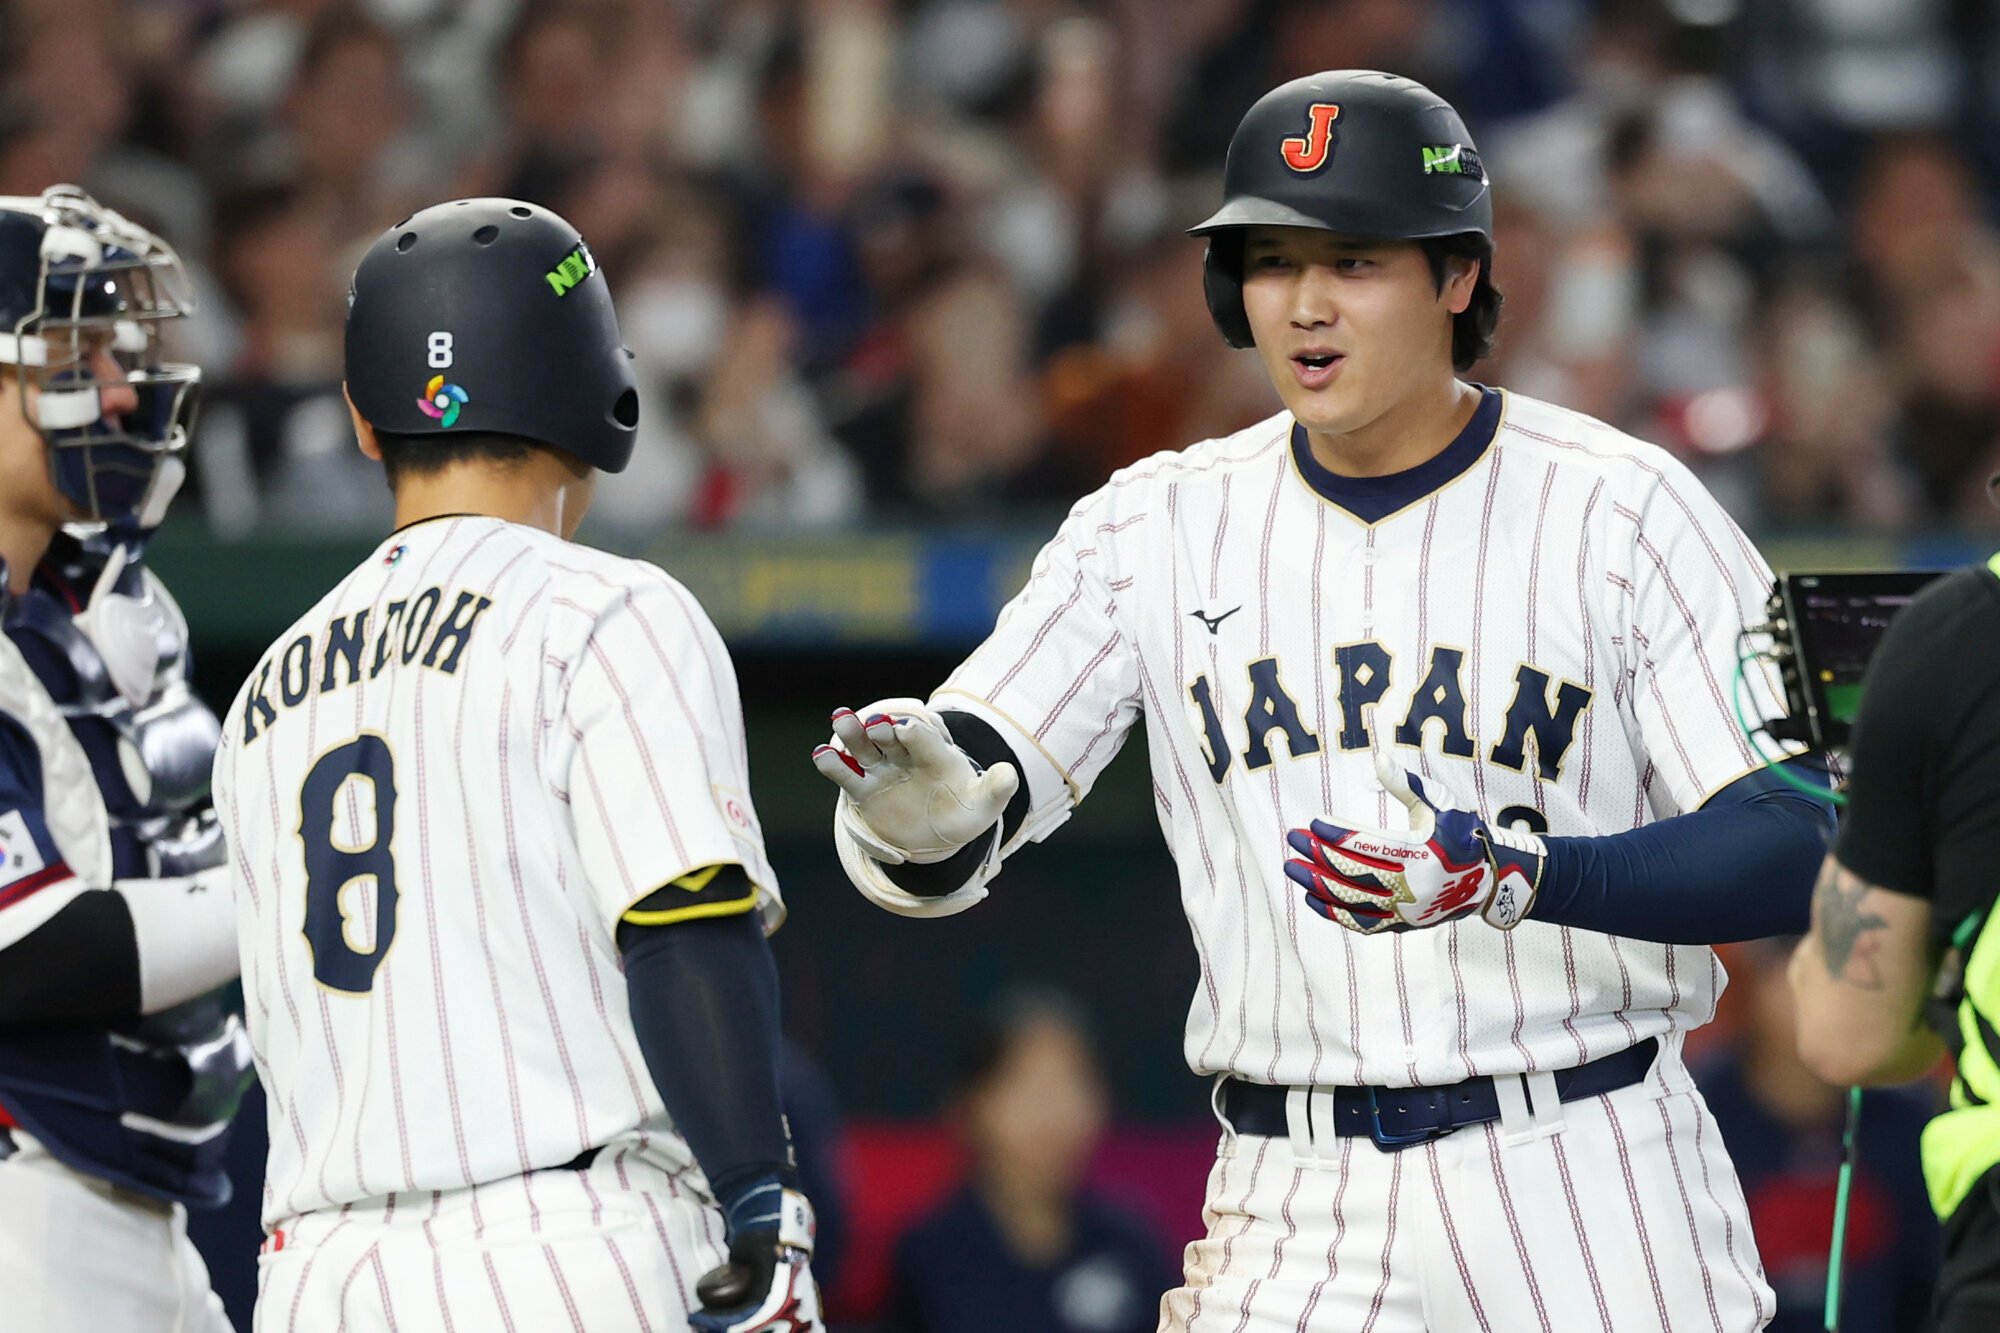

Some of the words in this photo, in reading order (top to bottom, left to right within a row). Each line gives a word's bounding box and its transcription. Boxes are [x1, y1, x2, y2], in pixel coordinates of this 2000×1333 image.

[1281, 104, 1339, 172] J
[427, 331, 453, 369] 8
[1189, 641, 1596, 785] JAPAN
[293, 728, 402, 999] 8
[1354, 841, 1380, 853] new
[1382, 844, 1429, 860] balance
